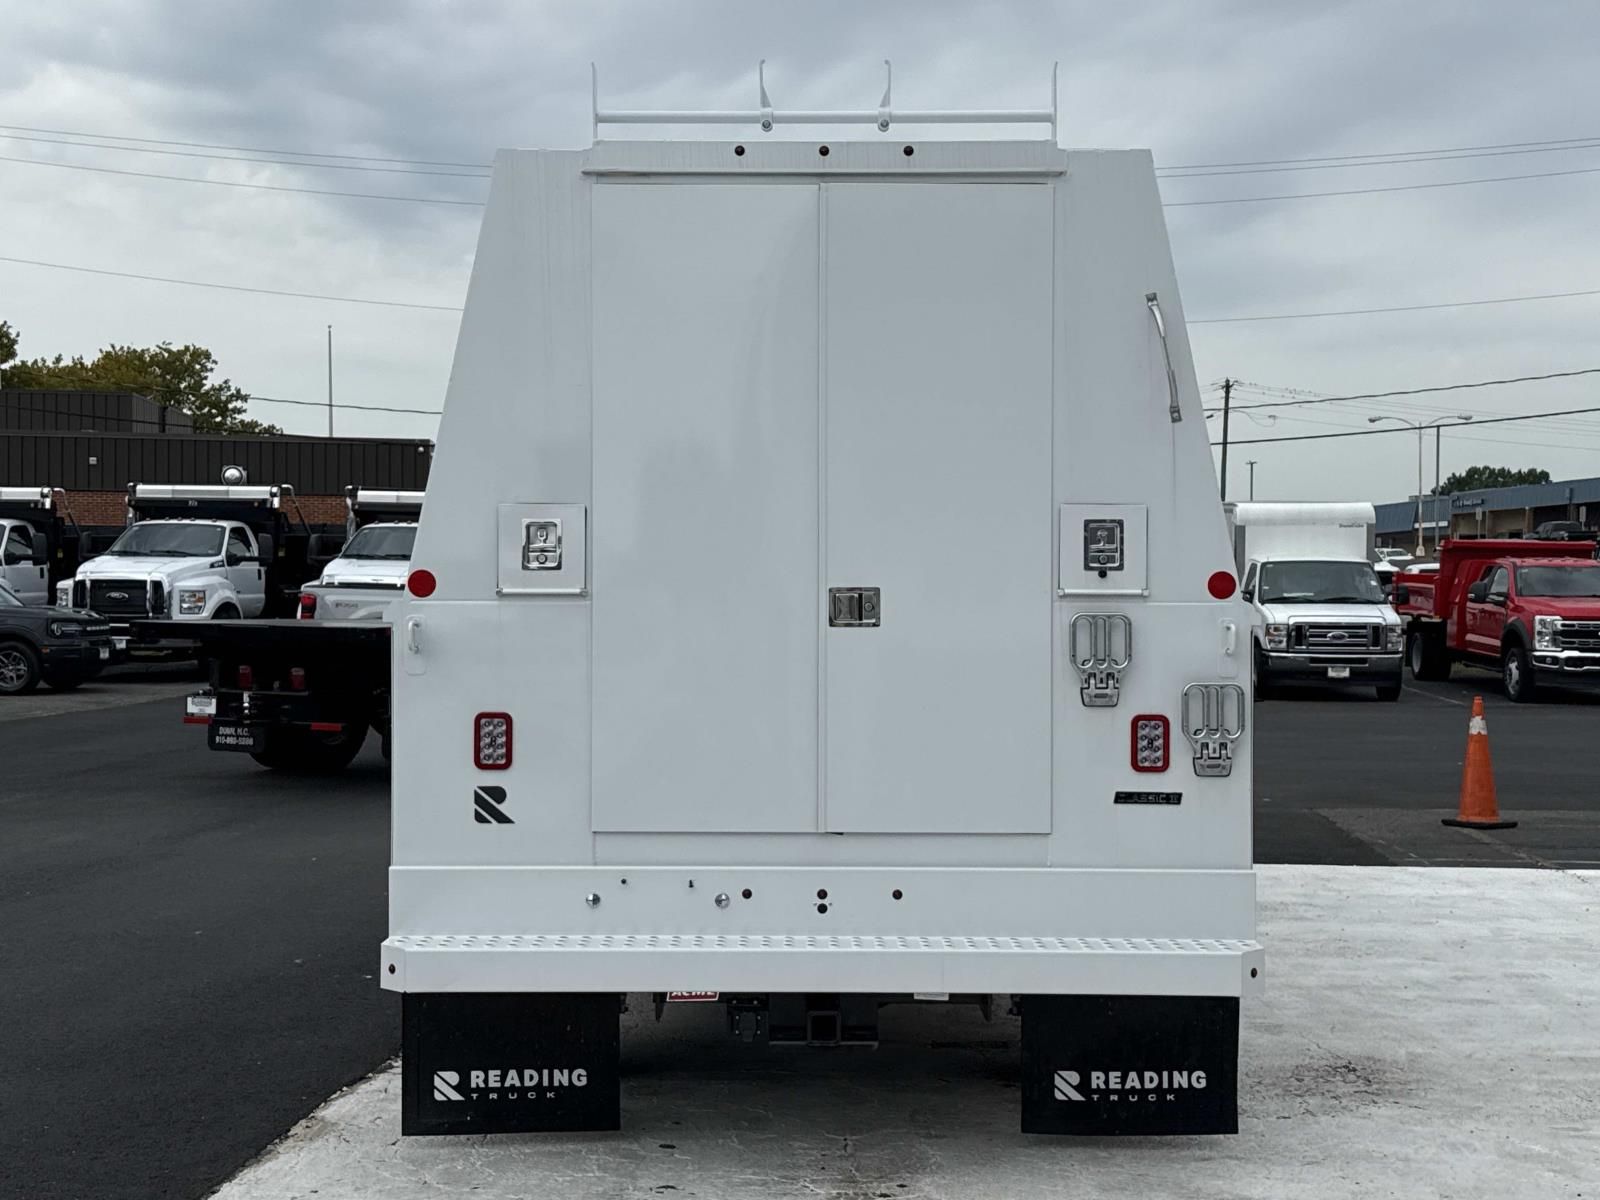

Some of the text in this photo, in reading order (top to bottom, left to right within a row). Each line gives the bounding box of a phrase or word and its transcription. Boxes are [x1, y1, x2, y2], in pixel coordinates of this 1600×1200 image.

[470, 1068, 588, 1088] READING
[1090, 1070, 1207, 1089] READING
[470, 1091, 556, 1100] TRUCK
[1090, 1093, 1176, 1101] TRUCK
